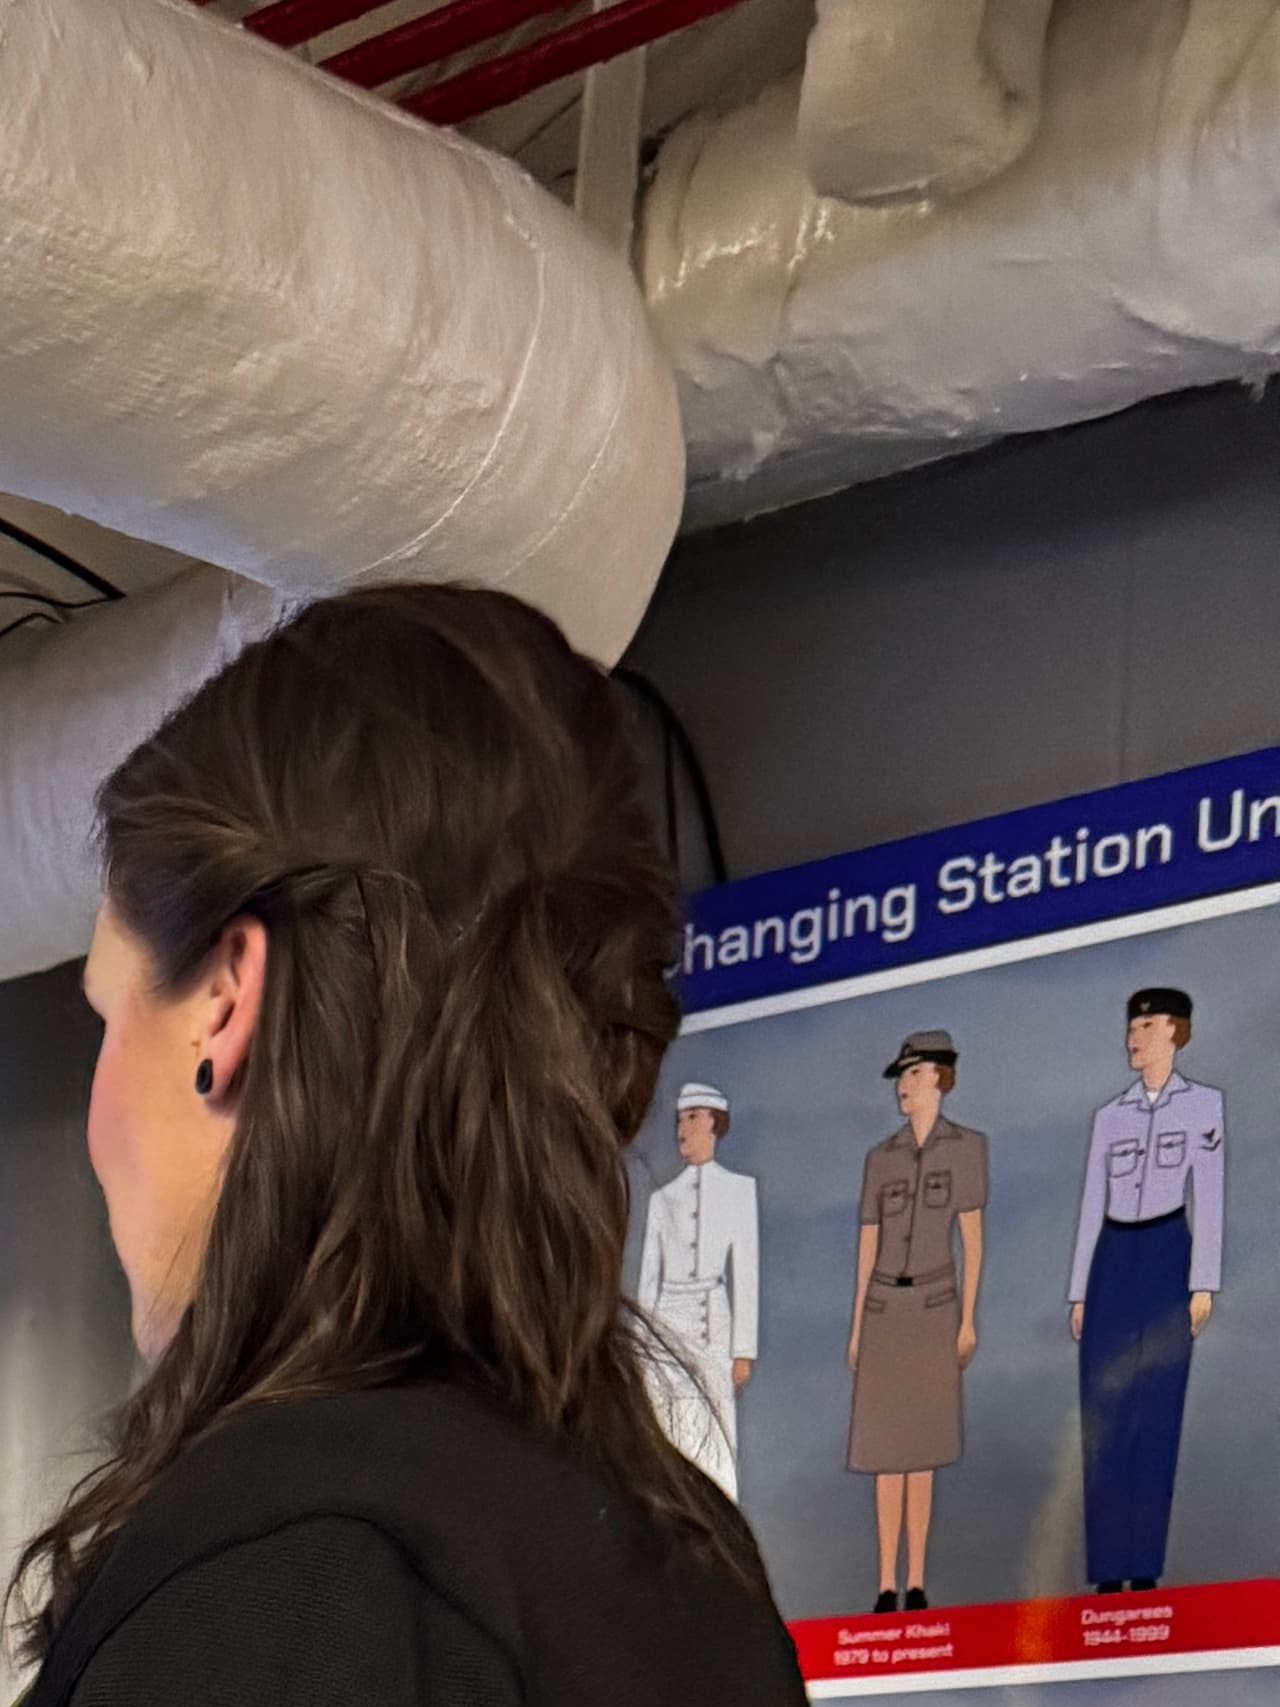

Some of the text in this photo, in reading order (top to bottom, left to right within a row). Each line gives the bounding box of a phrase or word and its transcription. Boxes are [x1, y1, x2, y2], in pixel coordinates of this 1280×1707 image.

[663, 787, 1280, 979] hanging Station Un
[1081, 1604, 1173, 1626] Dungarees
[837, 1627, 903, 1646] Summer
[871, 1646, 889, 1663] to
[891, 1642, 954, 1665] present
